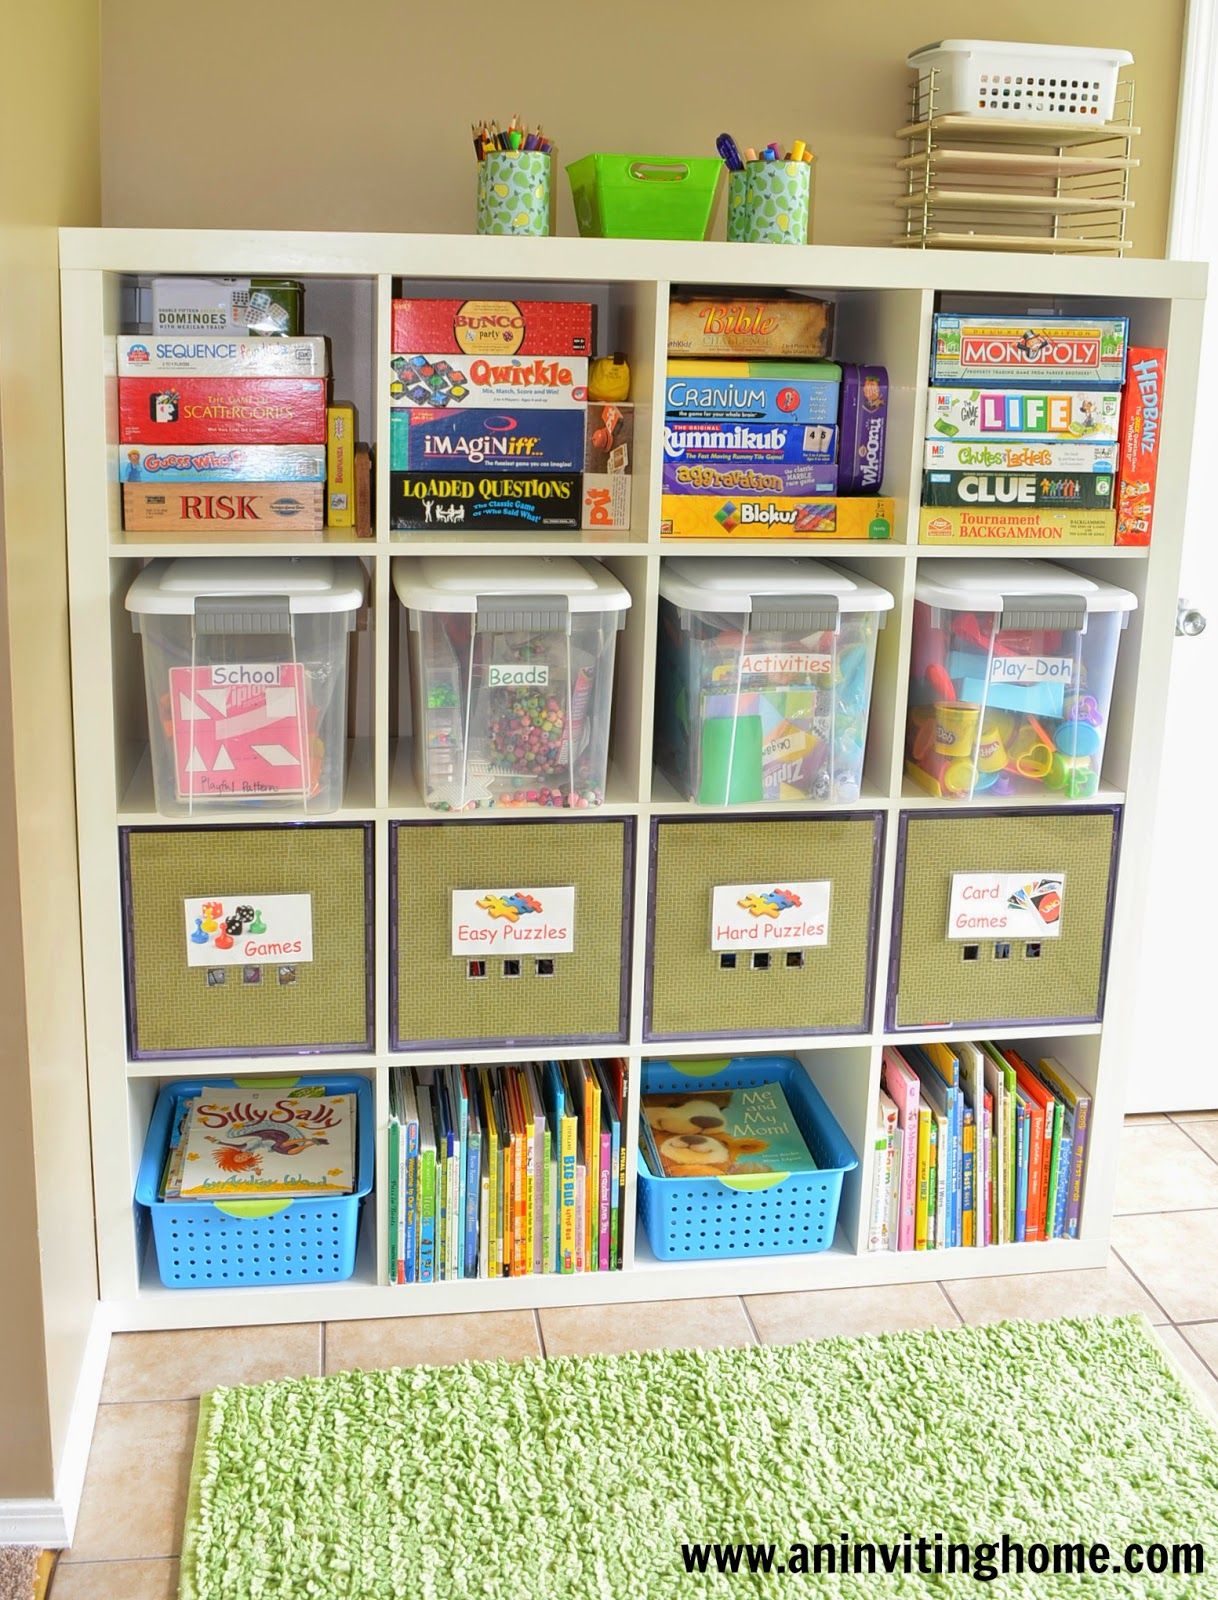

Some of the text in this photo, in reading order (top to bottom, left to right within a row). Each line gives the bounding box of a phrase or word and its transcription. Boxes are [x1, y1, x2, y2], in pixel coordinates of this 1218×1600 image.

[158, 313, 227, 324] DOMINOES
[454, 315, 526, 329] BUNCO
[698, 304, 780, 335] Bible
[479, 329, 500, 340] party
[156, 344, 237, 359] SEQUENCE
[965, 342, 1096, 364] MONOPOLY
[470, 359, 574, 388] Qwirkle
[183, 405, 294, 419] SCATTERGORIES
[984, 398, 1068, 428] LIFE
[1132, 358, 1160, 455] HEDBANZ
[664, 426, 786, 458] Rummikub
[810, 431, 815, 439] 4
[820, 431, 826, 439] 5
[144, 453, 192, 473] Guess
[958, 447, 1002, 466] Chutes
[1004, 447, 1052, 468] Ladders
[676, 465, 784, 493] aggravation
[402, 478, 571, 500] LOADED QUESTIONS
[958, 476, 1036, 503] CLUE
[179, 496, 262, 520] RISK
[488, 500, 514, 508] Classic
[514, 500, 536, 512] Game
[502, 508, 520, 518] Said
[584, 488, 614, 526] pit
[740, 503, 799, 528] Blokus
[960, 512, 1040, 526] Tournament
[960, 526, 1063, 539] BACKGAMMON
[742, 655, 831, 673] Activities
[992, 659, 1072, 680] Play-Doh
[214, 665, 280, 685] School
[490, 667, 547, 685] Beads
[764, 758, 804, 787] Ziplo
[962, 884, 1000, 901] Card
[956, 914, 1008, 929] Games
[458, 924, 568, 943] Easy Puzzles
[716, 922, 825, 941] Hard Puzzles
[244, 940, 302, 957] Games
[742, 1091, 772, 1105] Me
[746, 1099, 777, 1112] and
[196, 1100, 342, 1130] Silly Sally
[744, 1112, 776, 1124] My
[734, 1122, 790, 1137] Mom!
[564, 1156, 574, 1179] BIG
[906, 1153, 915, 1179] Princess
[1072, 1146, 1083, 1202] my first words
[906, 1180, 914, 1200] Stories
[964, 1171, 972, 1190] Best
[601, 1203, 609, 1220] Loves
